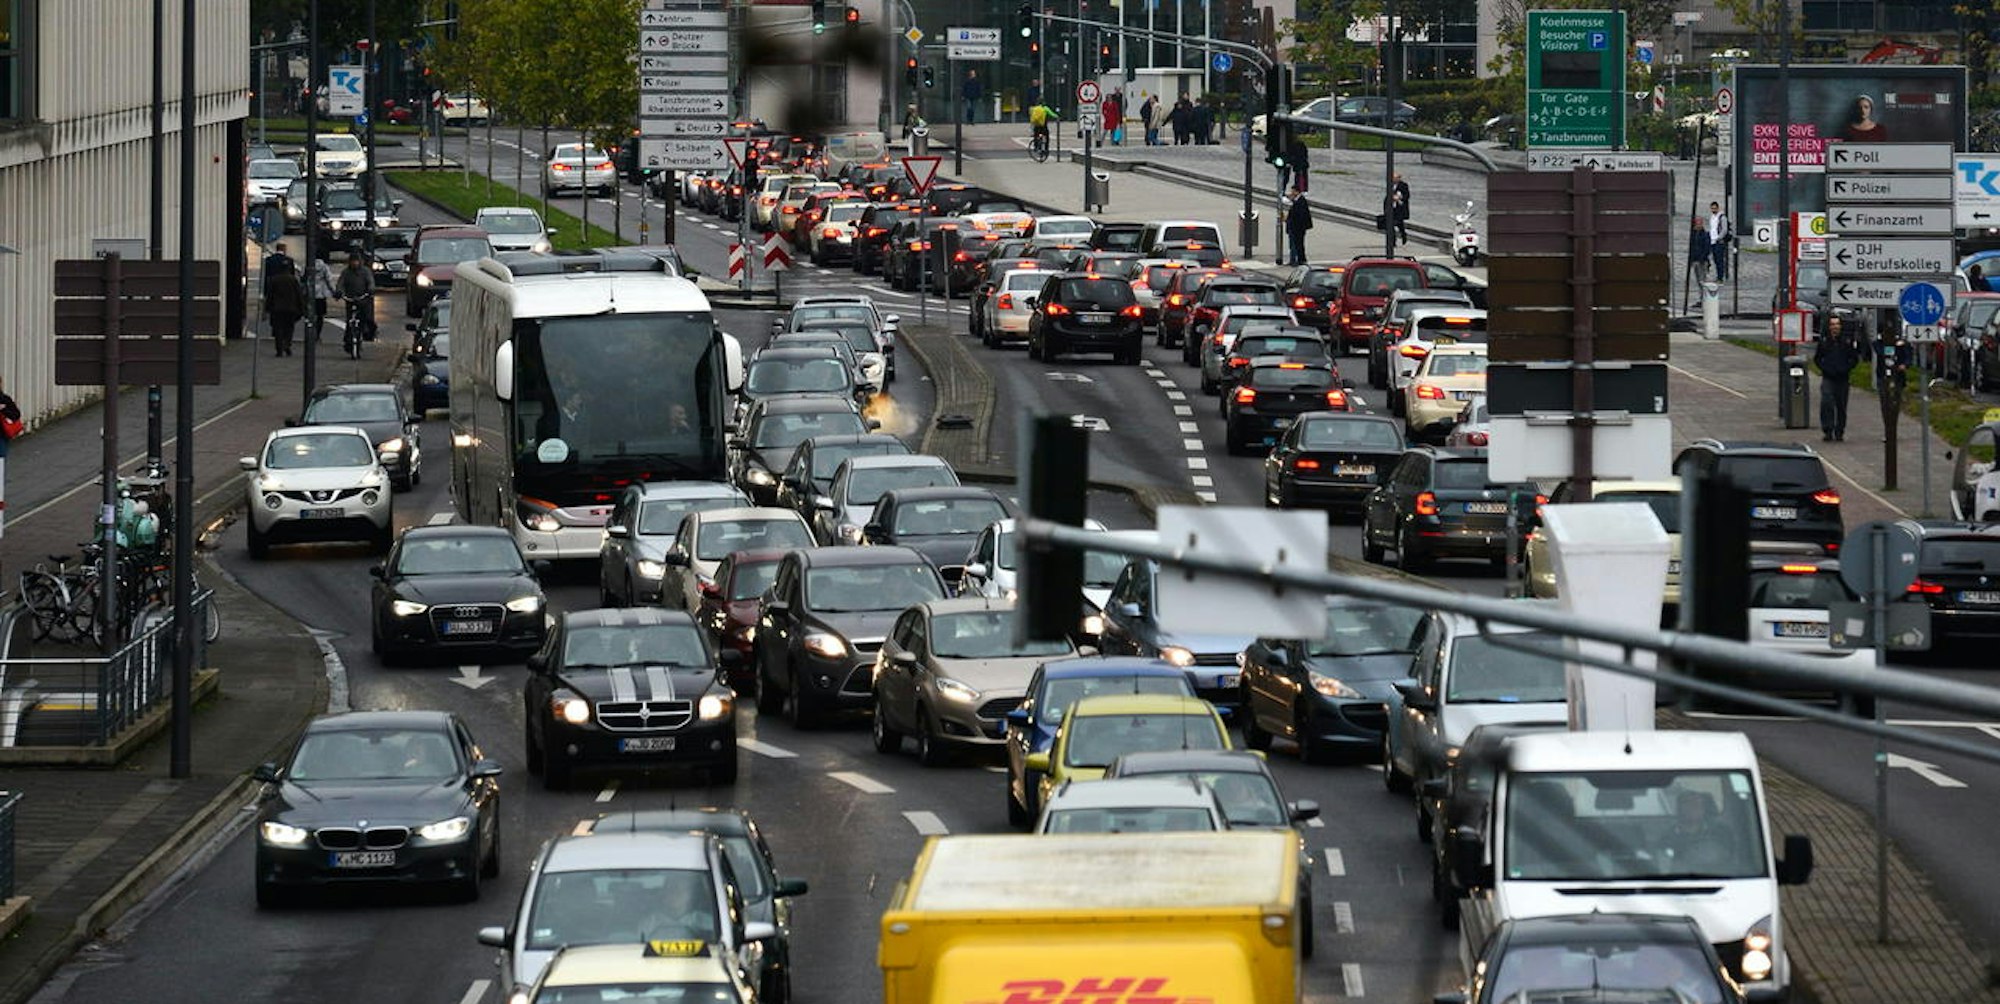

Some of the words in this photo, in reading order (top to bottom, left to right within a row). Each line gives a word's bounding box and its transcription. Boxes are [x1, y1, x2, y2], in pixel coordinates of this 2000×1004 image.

[658, 15, 694, 23] Zentrum
[1540, 17, 1605, 27] Koelnmesse
[672, 33, 704, 41] Deutzer
[1540, 30, 1586, 40] Besucher
[1540, 41, 1578, 50] Visitors
[1593, 34, 1604, 47] P
[332, 71, 361, 94] TK
[656, 79, 681, 87] Polizei
[1541, 94, 1557, 103] Tor
[1564, 94, 1589, 103] Gate
[648, 105, 711, 113] Rheinterrassen
[687, 124, 711, 132] Deutz
[1541, 132, 1606, 142] Tanzbrunnen
[676, 144, 711, 152] Seilbahn
[1754, 139, 1822, 151] TOP-ERIEN
[663, 157, 711, 165] Thermalbad
[1854, 151, 1880, 163] Poll
[1958, 162, 2000, 195] TK
[1852, 182, 1891, 194] Polizei
[1856, 214, 1924, 226] Finanzamt
[1757, 228, 1770, 242] C
[1856, 244, 1883, 255] DJH
[1856, 258, 1942, 273] Berufskolleg
[660, 941, 697, 953] TAXI
